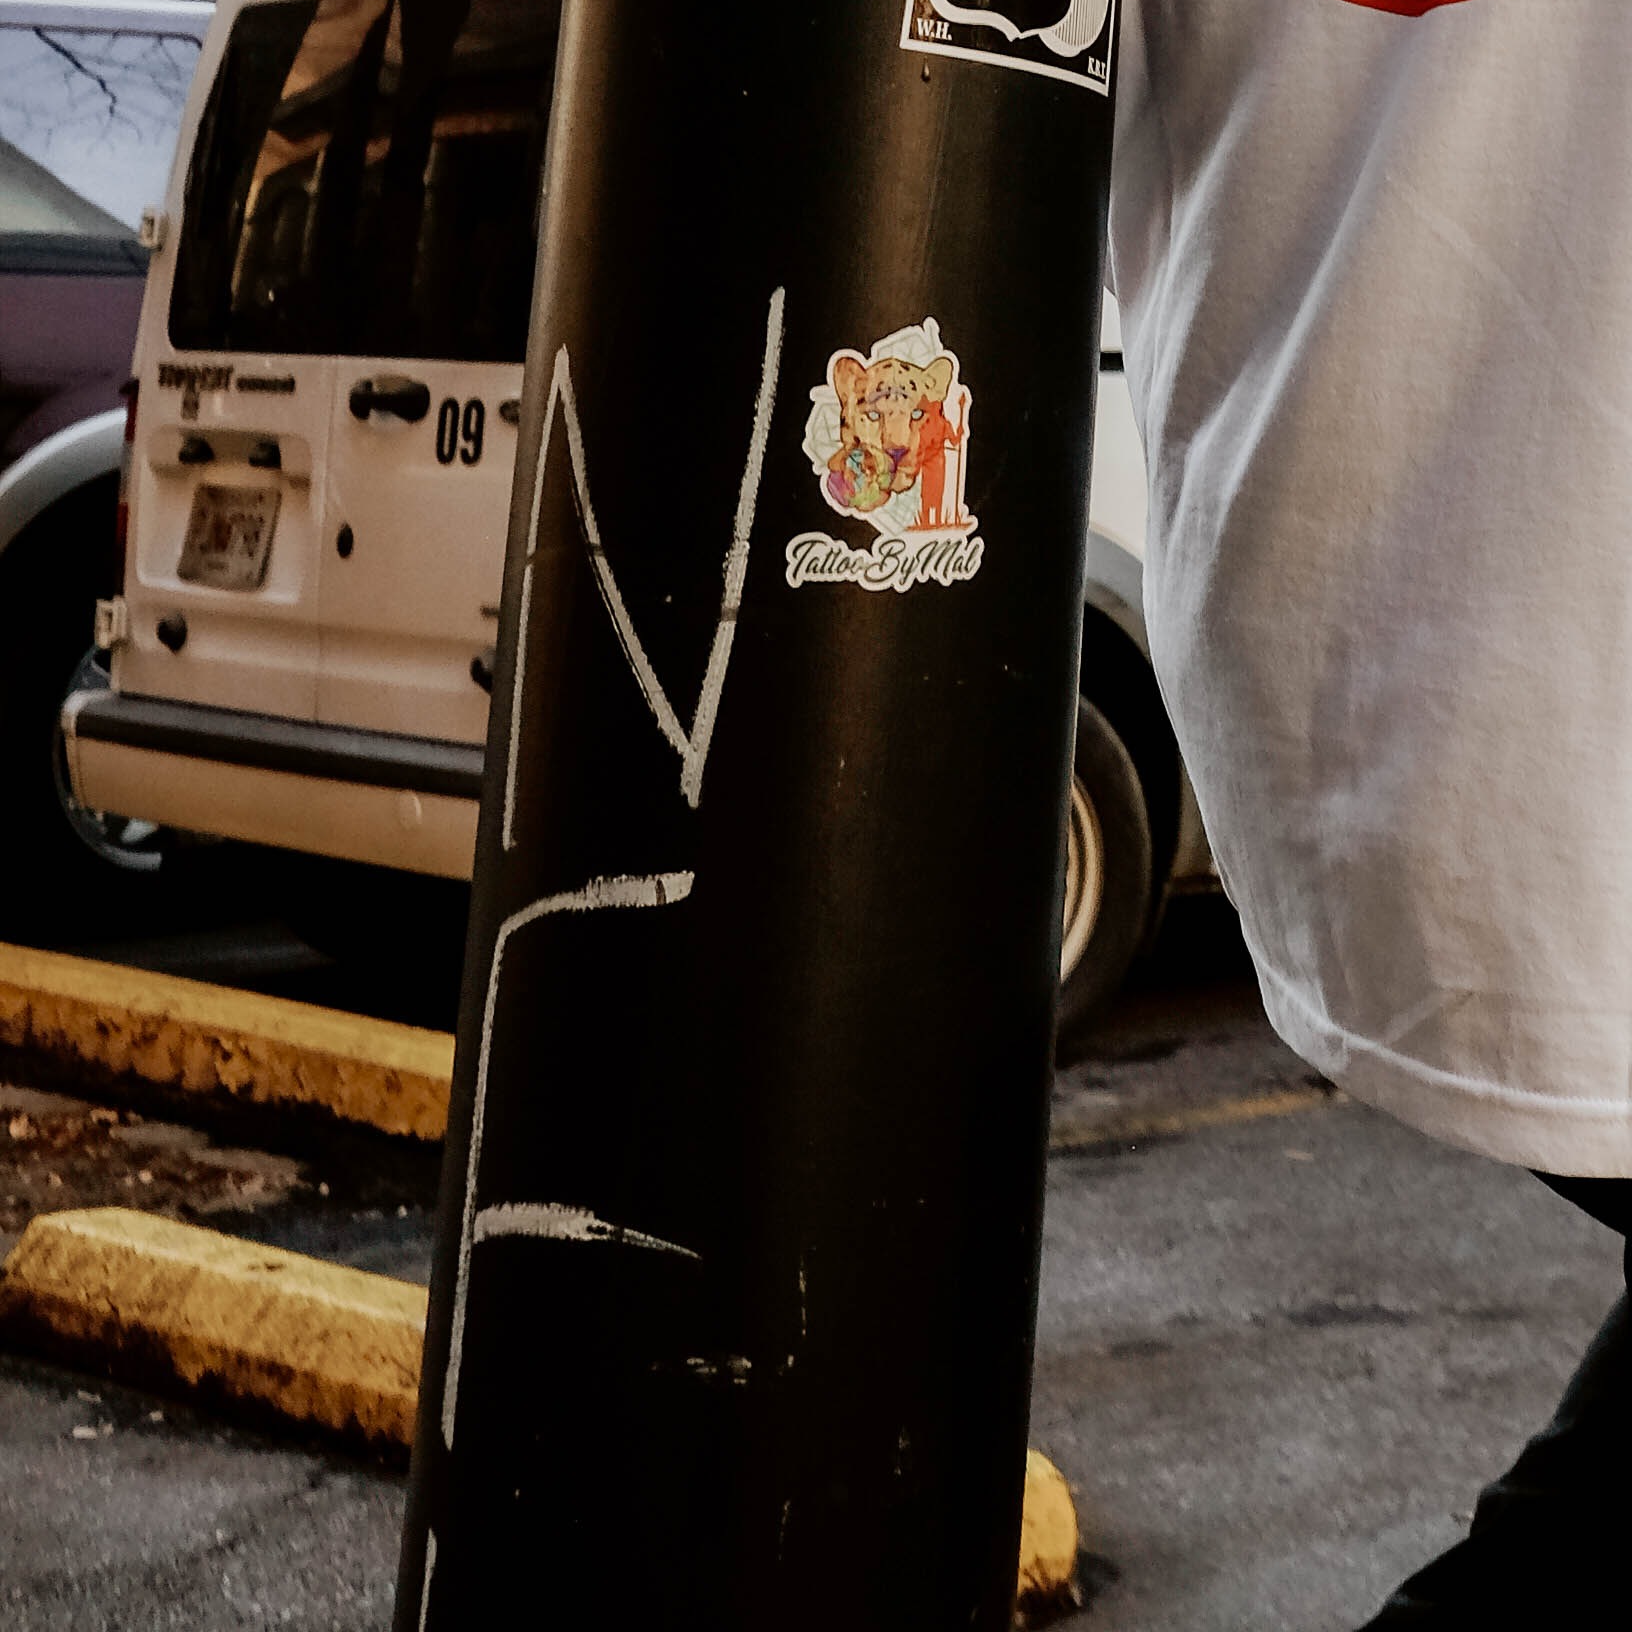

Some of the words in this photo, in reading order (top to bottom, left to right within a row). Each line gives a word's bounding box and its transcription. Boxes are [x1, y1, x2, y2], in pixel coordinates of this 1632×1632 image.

[917, 17, 953, 42] W.H.
[436, 397, 484, 466] 09
[792, 539, 866, 576] Tattoo
